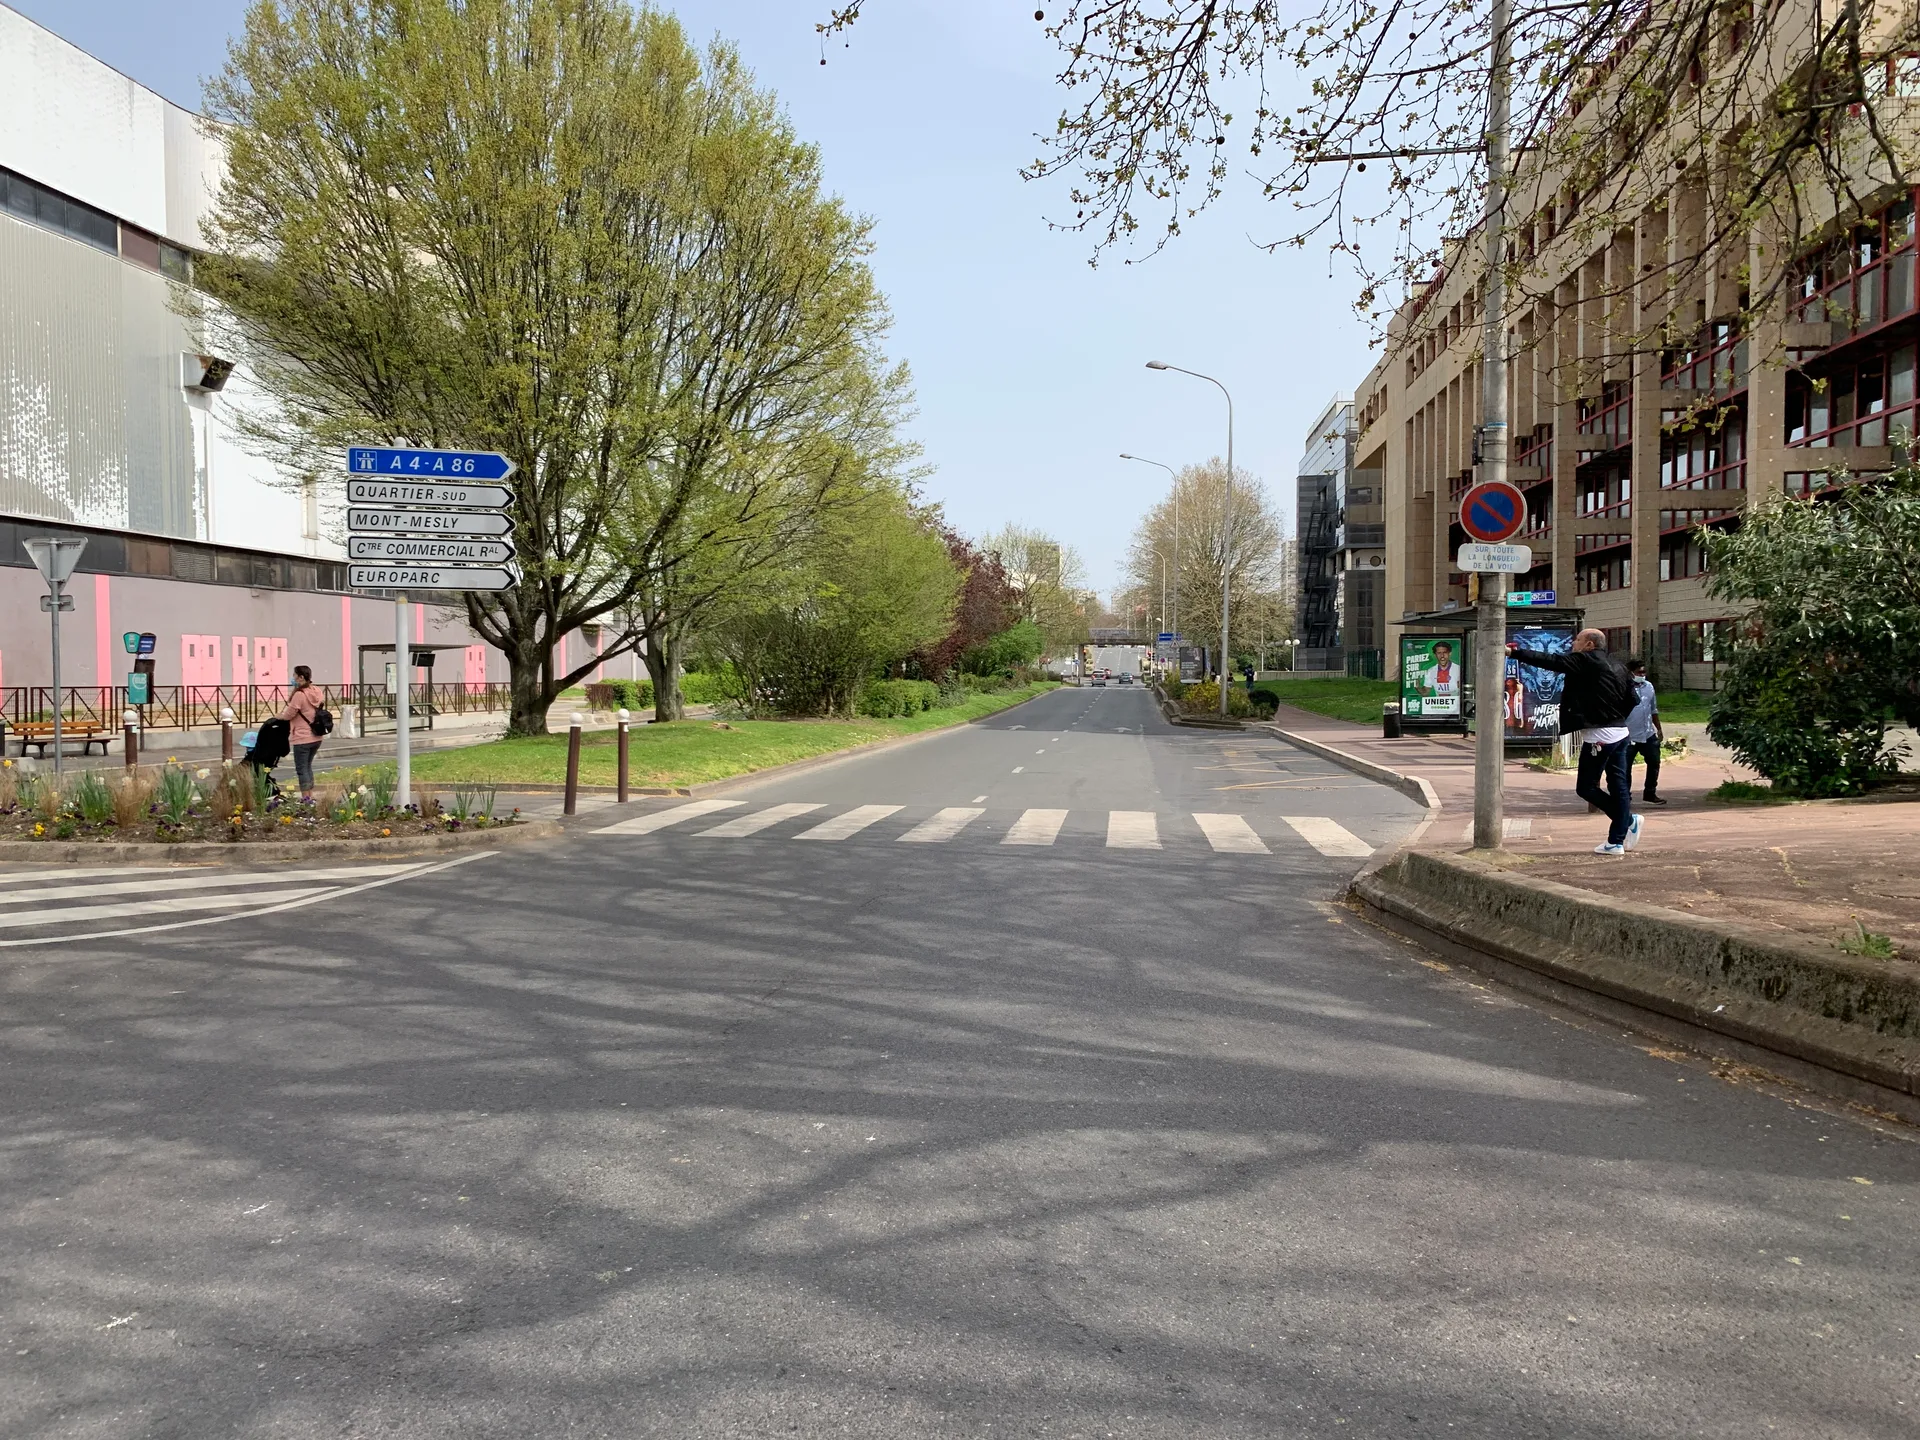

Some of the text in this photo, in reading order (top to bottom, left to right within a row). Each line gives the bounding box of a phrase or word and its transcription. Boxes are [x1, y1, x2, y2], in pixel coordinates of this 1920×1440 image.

[355, 514, 459, 529] MONT-MESLY
[386, 543, 475, 557] COMMERCIAL
[1493, 546, 1514, 554] TOUTE
[1482, 554, 1520, 562] LONGUEUR
[357, 570, 440, 584] EUROPARC
[1406, 653, 1430, 664] PARIEZ
[1406, 663, 1420, 672] SUR
